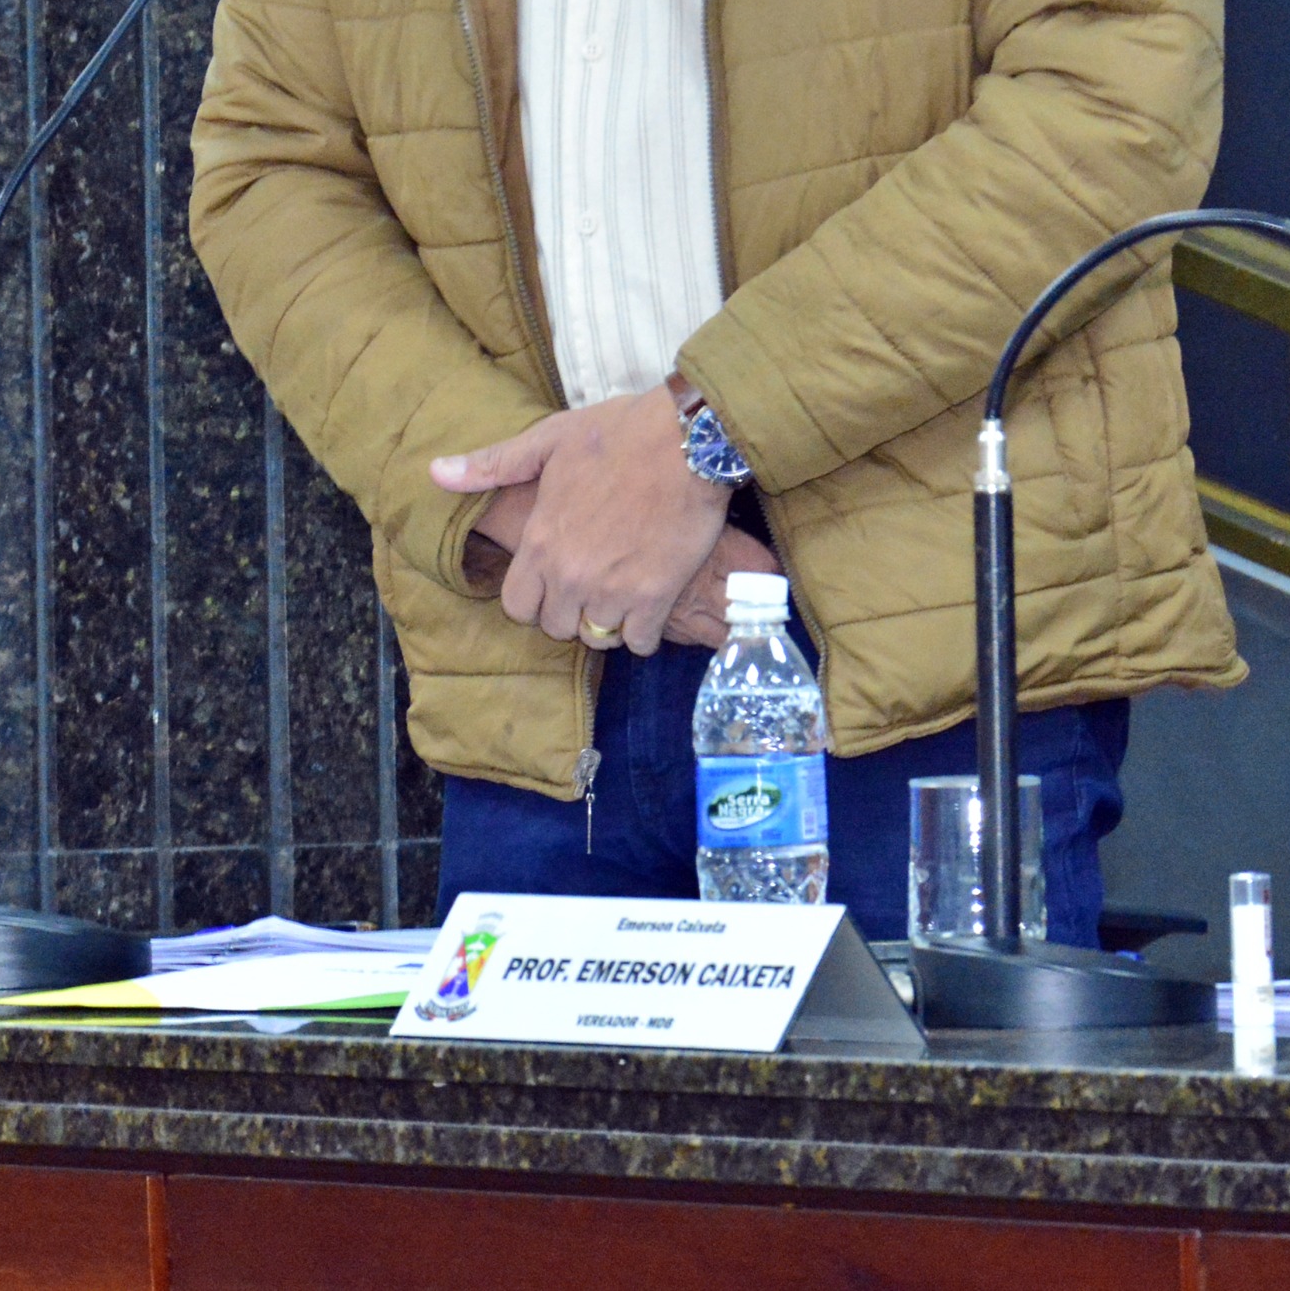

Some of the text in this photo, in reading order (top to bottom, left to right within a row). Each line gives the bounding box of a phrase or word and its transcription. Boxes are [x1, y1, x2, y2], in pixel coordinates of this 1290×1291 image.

[727, 794, 771, 806] Serra
[717, 803, 765, 819] Negra
[617, 917, 726, 934] Emerson Caixeta
[502, 957, 795, 989] PROF. EMERSON CAIXETA
[576, 1014, 639, 1028] VEREADOR
[647, 1016, 674, 1029] MDB
